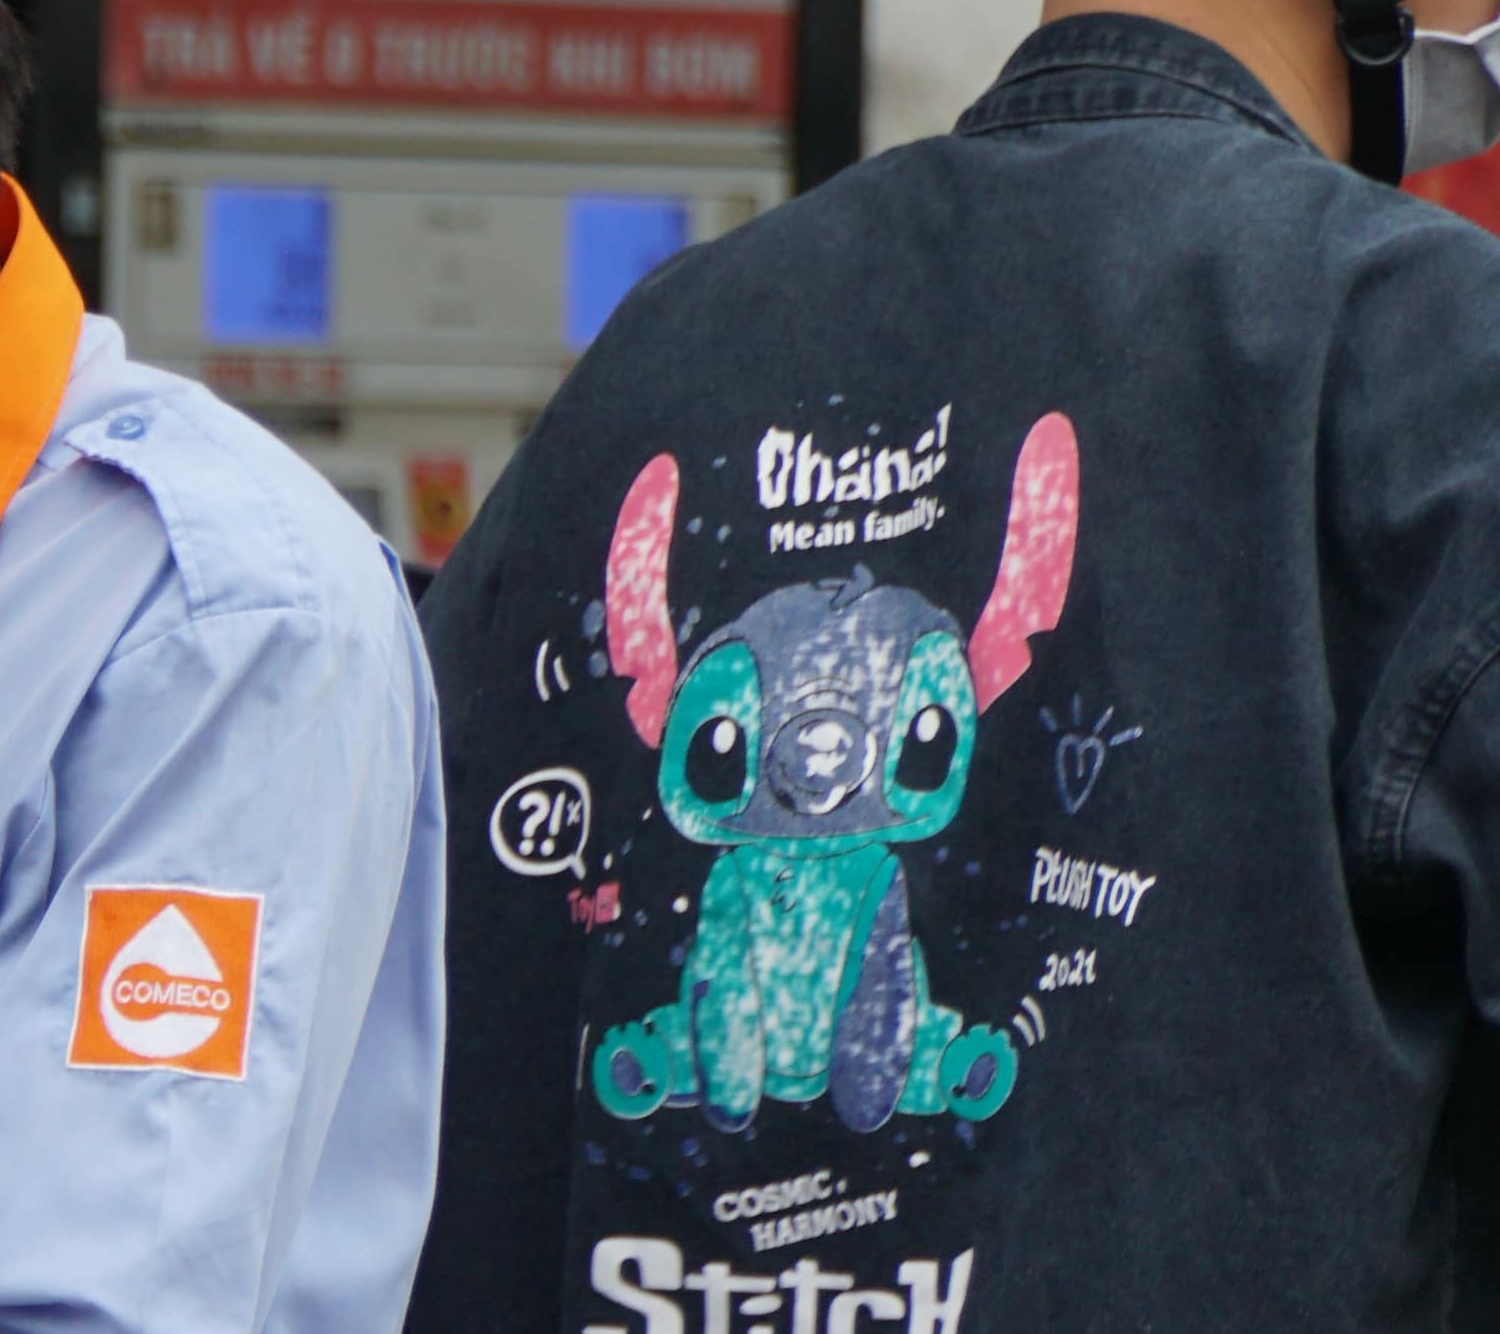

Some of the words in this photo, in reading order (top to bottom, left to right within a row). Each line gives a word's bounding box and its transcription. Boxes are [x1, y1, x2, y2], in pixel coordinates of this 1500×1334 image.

[770, 520, 856, 554] Mean
[863, 496, 946, 544] family.
[1030, 845, 1097, 911] PLUSH
[1095, 864, 1158, 928] TOY
[114, 979, 232, 1012] COMECO
[1038, 947, 1098, 992] 2021
[749, 1188, 899, 1253] HARMONY
